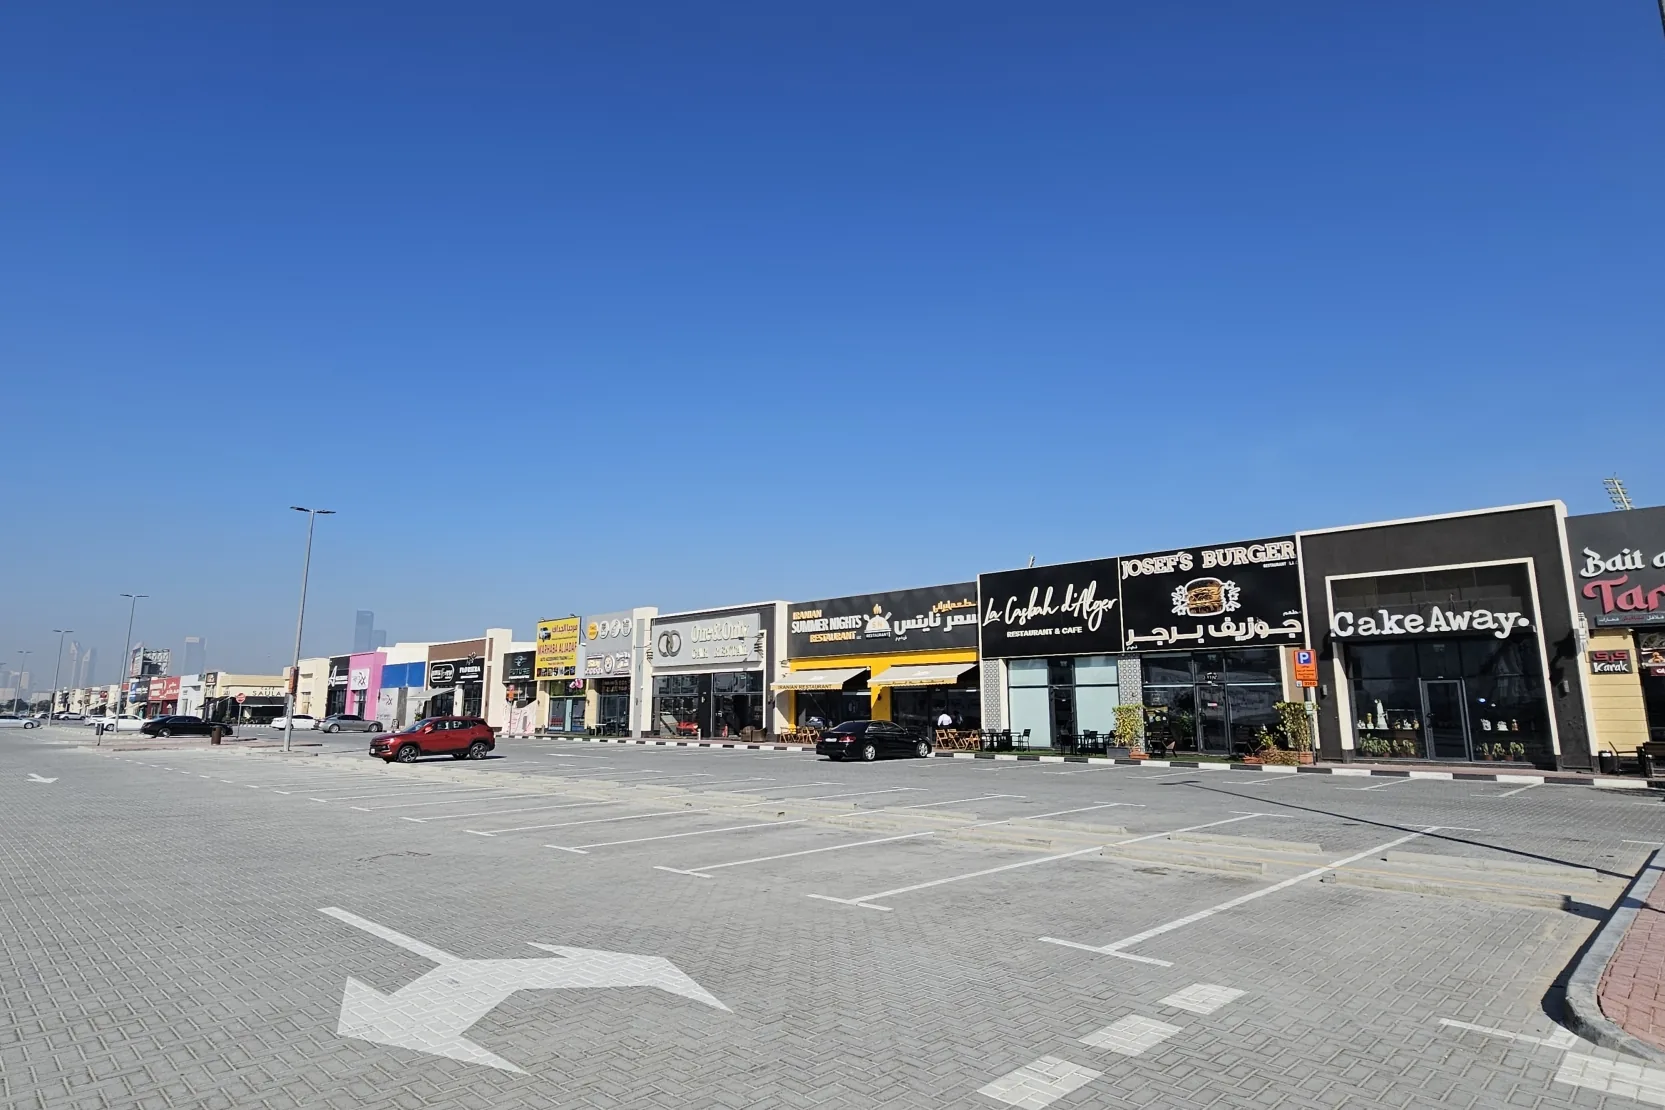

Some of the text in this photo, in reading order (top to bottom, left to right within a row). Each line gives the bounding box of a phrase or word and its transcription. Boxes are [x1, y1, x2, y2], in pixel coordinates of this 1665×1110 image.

[1121, 541, 1296, 580] JOSEF'S BURGER
[1580, 547, 1646, 577] Bait
[982, 597, 1003, 627] La
[1005, 586, 1059, 625] Casbah
[792, 610, 822, 620] IRANIAN
[792, 615, 862, 633] SUMMER NIGHTS
[1125, 617, 1303, 645] جوزيف برجر
[809, 631, 857, 643] RESTAURANT
[1007, 628, 1053, 638] RESTAURANT
[1062, 626, 1083, 634] CAFE
[1300, 652, 1309, 664] P
[1593, 660, 1629, 673] Karak
